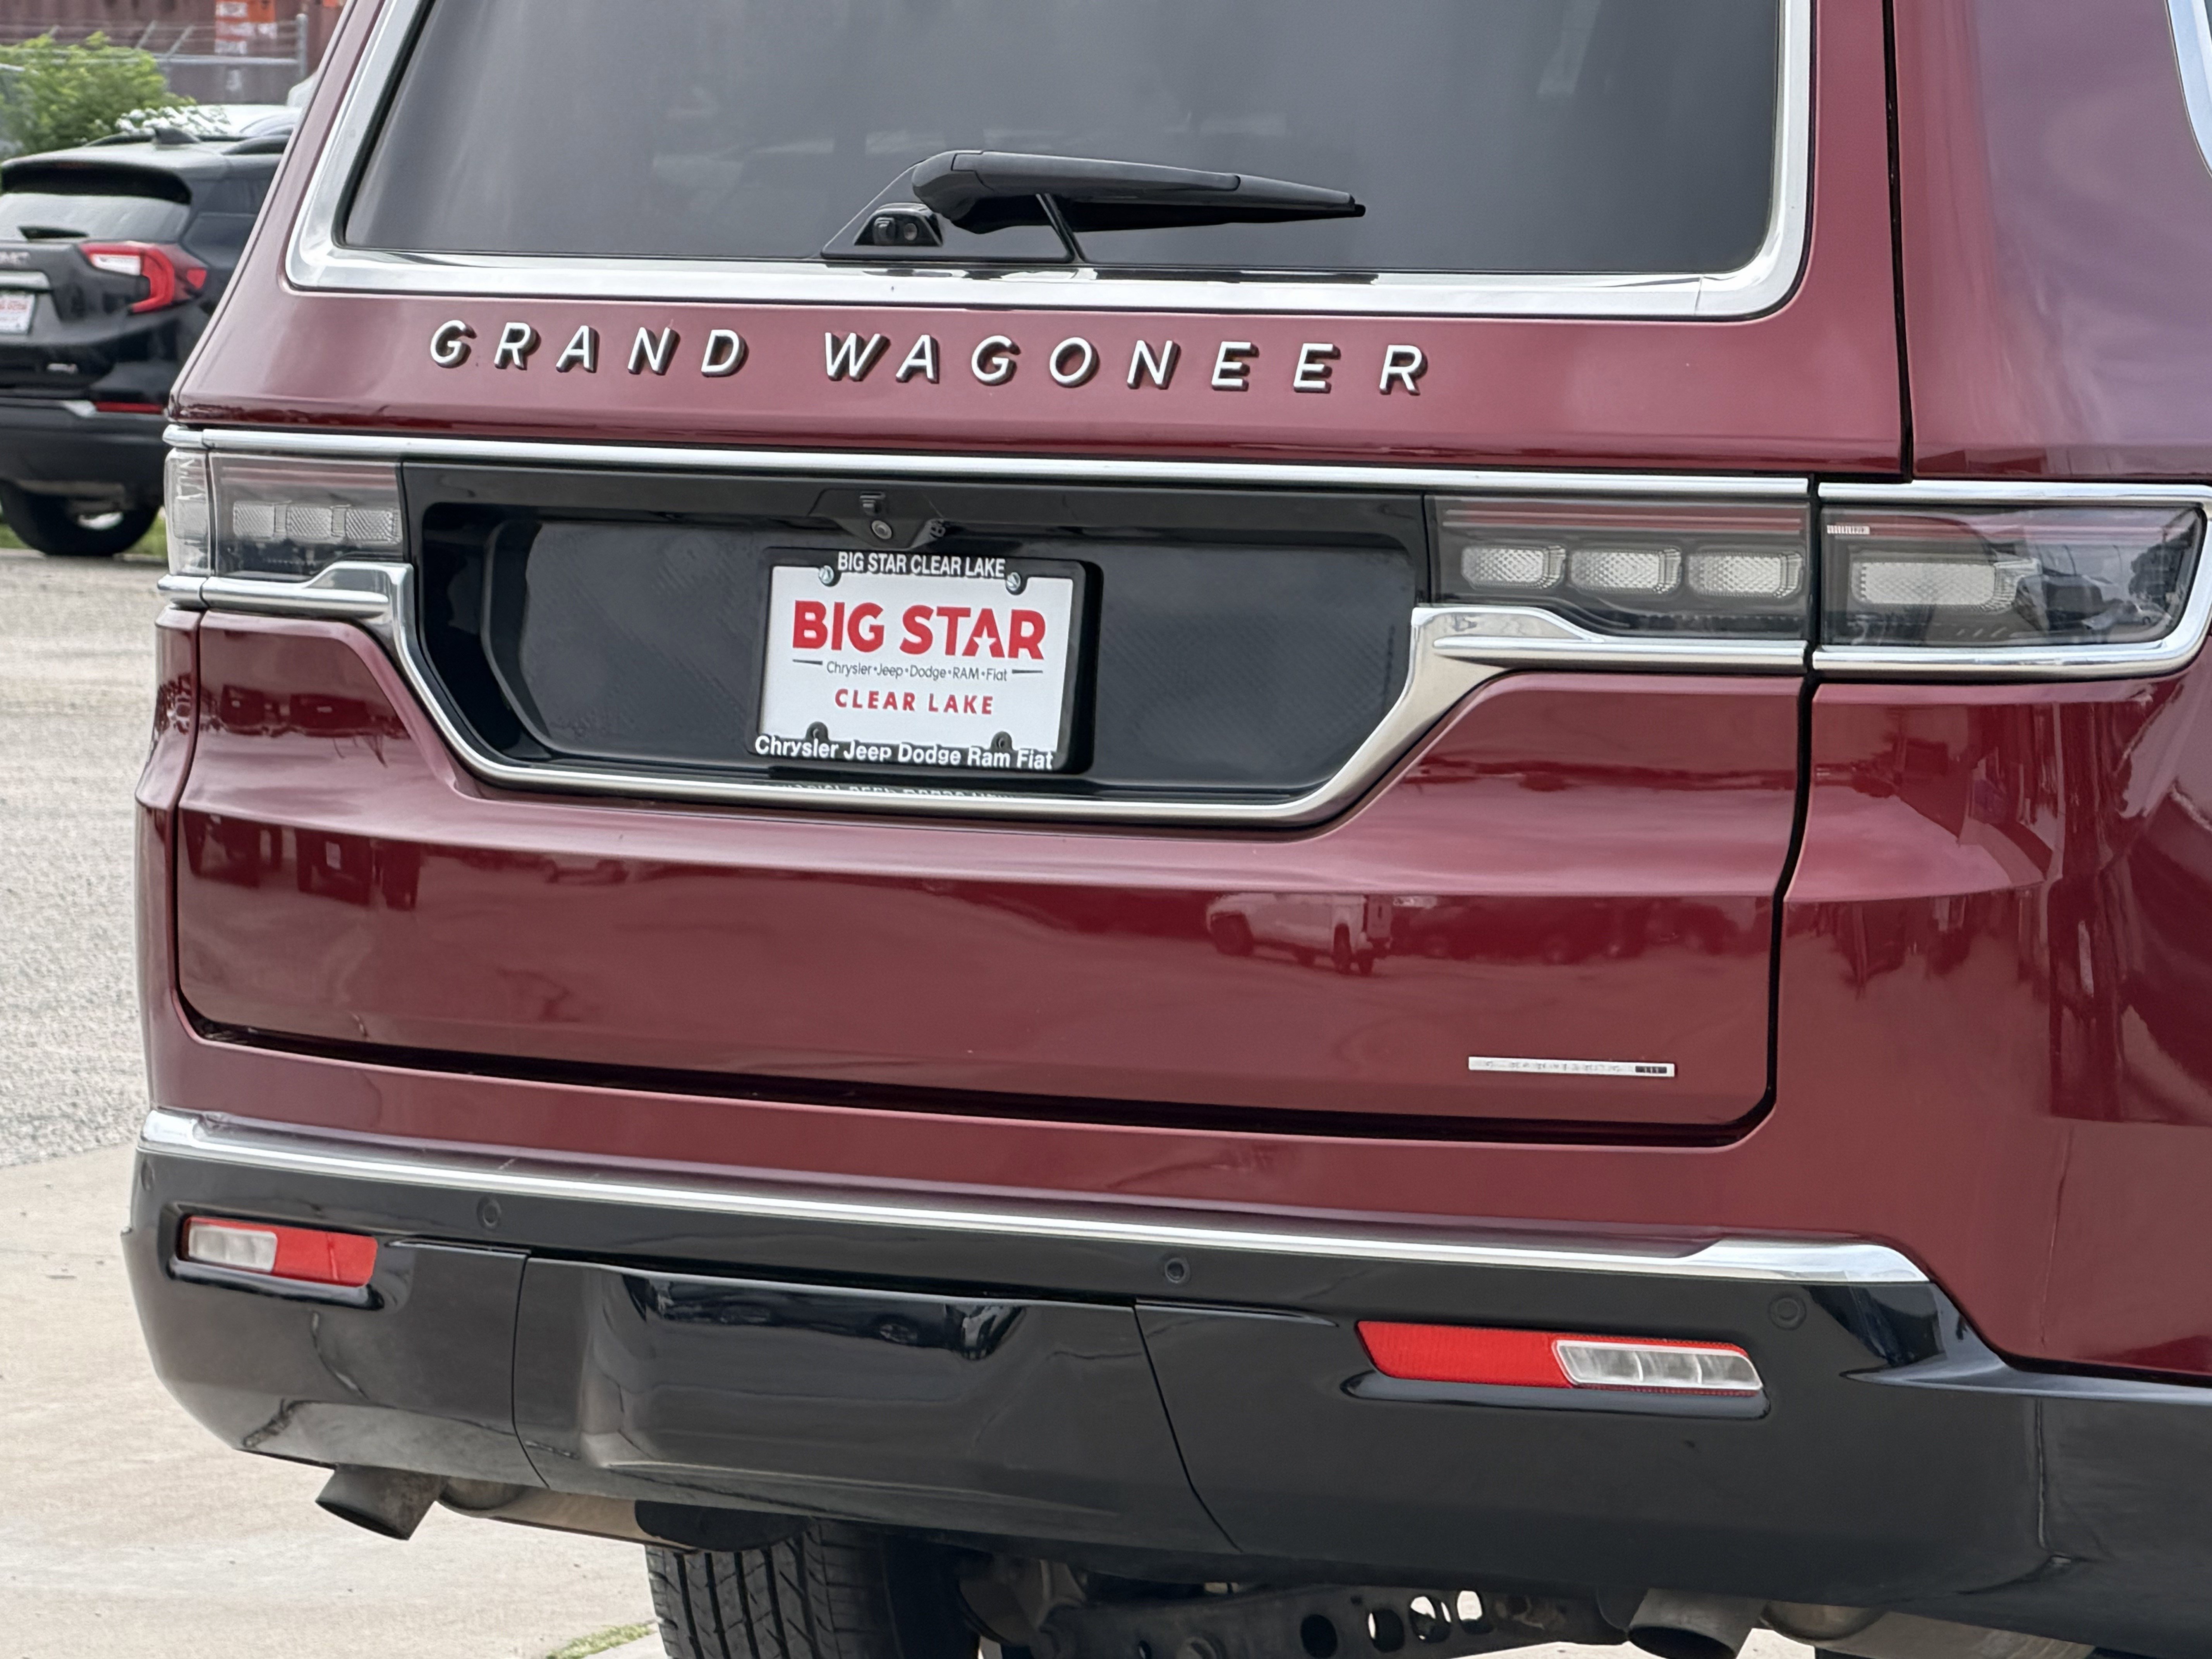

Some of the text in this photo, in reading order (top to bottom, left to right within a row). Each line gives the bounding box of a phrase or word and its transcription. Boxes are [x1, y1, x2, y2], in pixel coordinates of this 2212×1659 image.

[430, 320, 1428, 395] GRAND WAGONEER
[838, 551, 1005, 577] BIG STAR CLEAR LAKE
[793, 600, 1046, 660] BIG STAR
[826, 661, 871, 677] Chrysler
[877, 664, 903, 679] Jeep
[910, 665, 947, 681] Dodge
[953, 667, 979, 680] RAM
[835, 689, 993, 714] CLEAR LAKE
[755, 736, 1054, 769] Chrysler Jeep Dodge Ram Fiat
